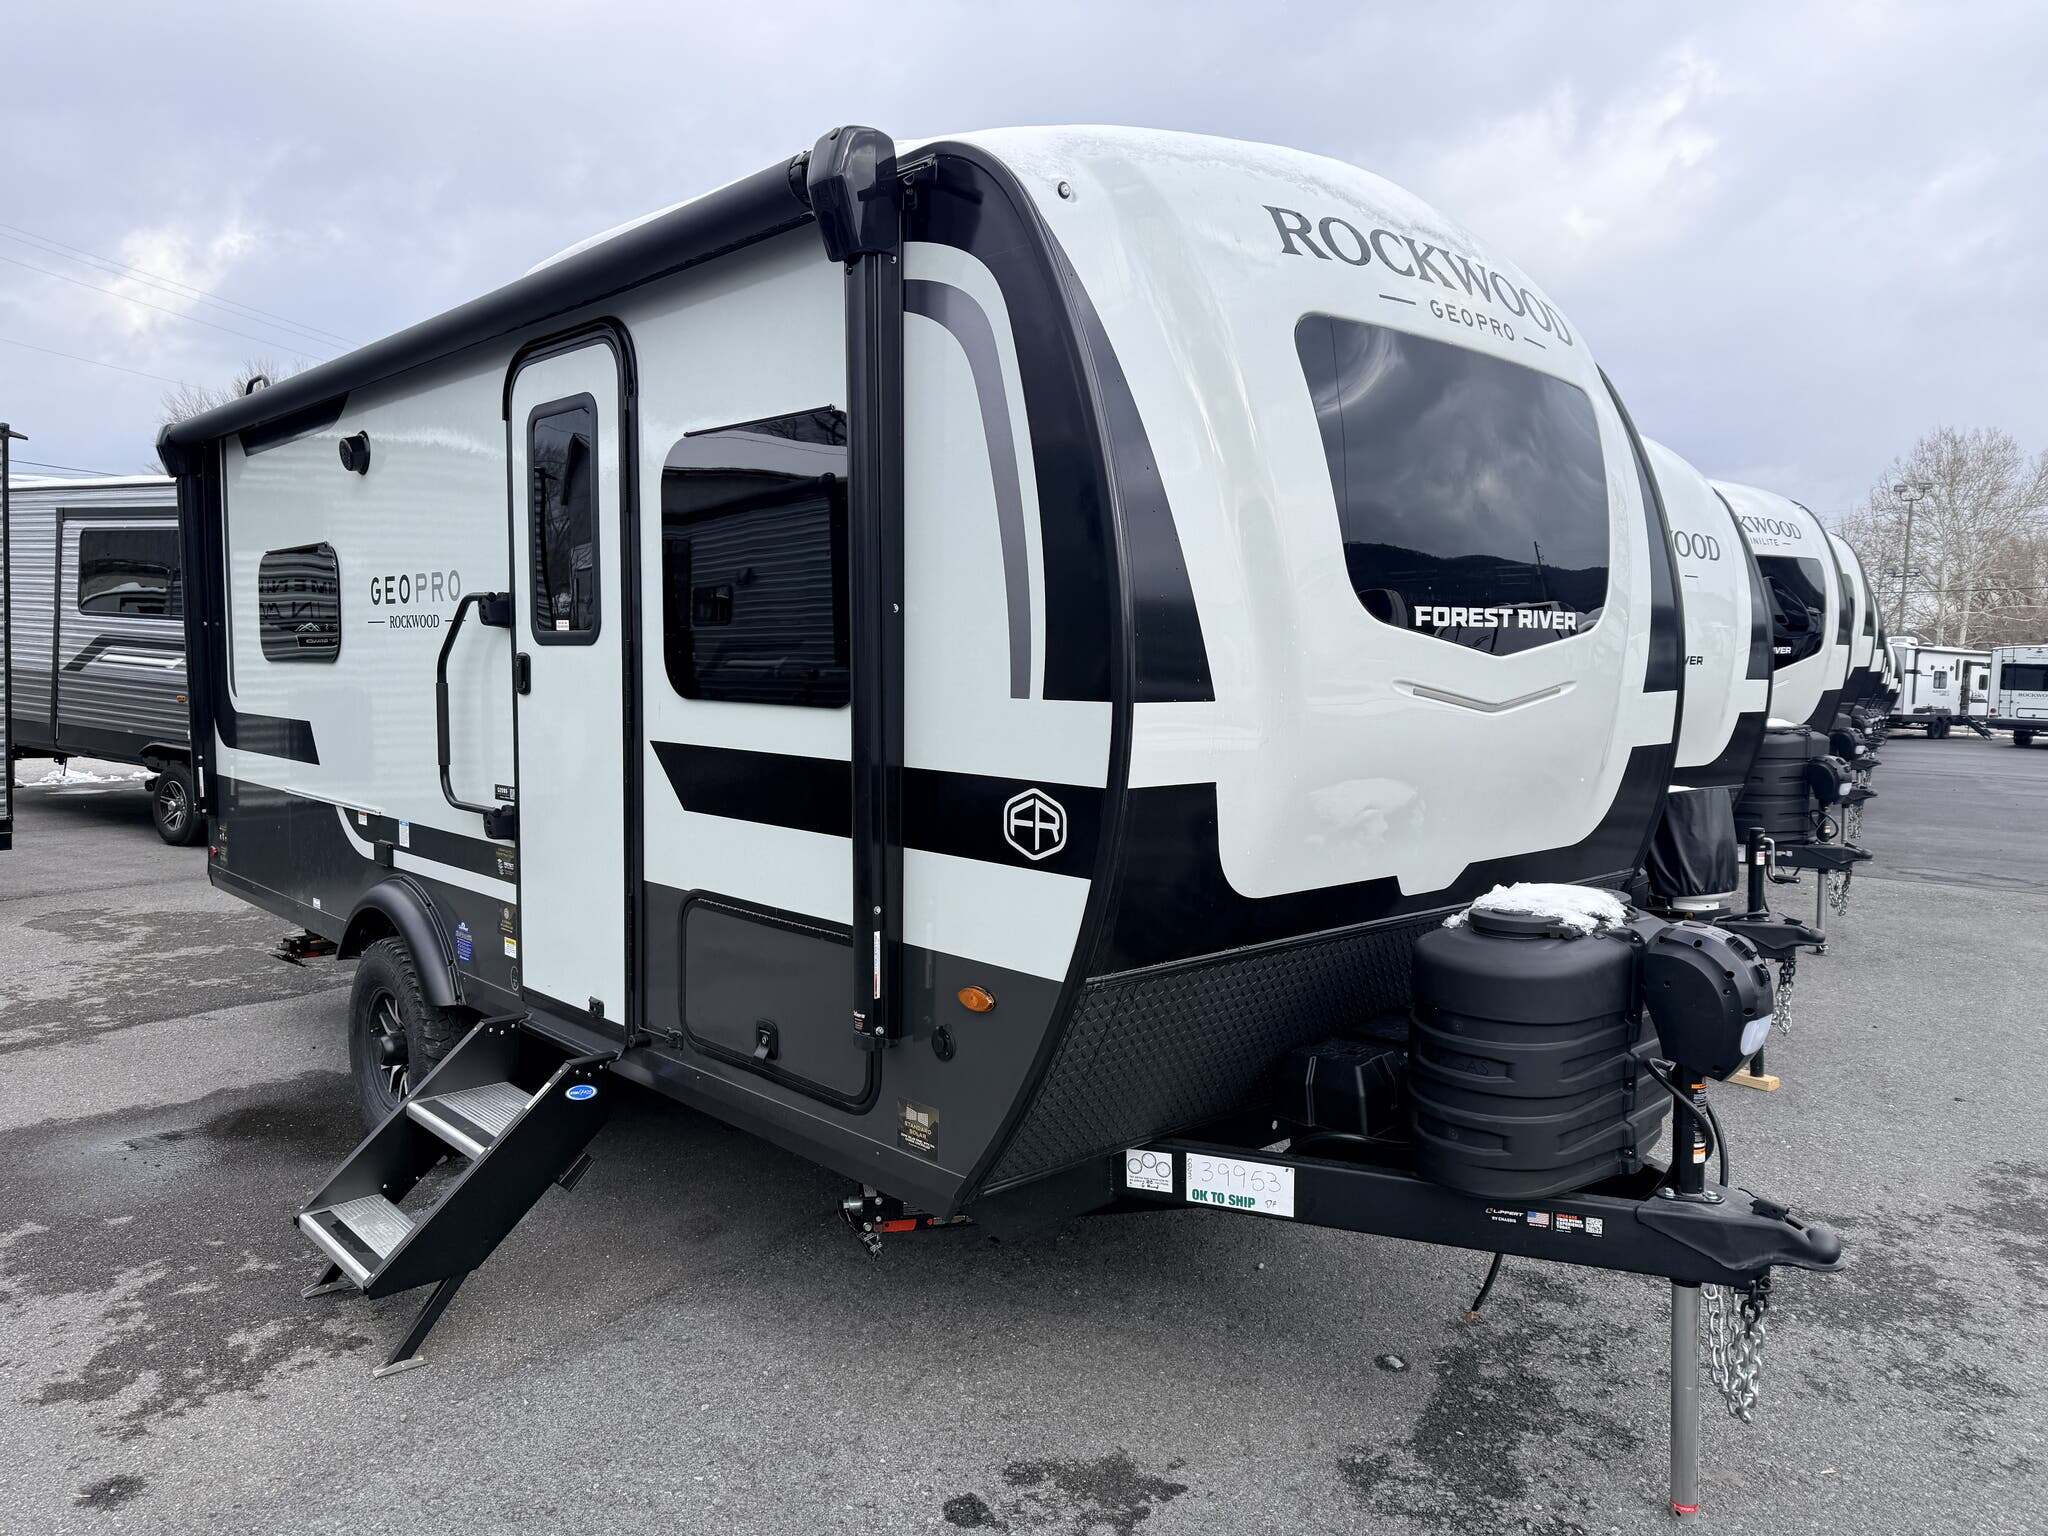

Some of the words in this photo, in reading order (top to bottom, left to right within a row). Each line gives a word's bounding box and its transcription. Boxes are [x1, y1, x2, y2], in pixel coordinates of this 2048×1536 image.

[1261, 204, 1574, 347] ROCKWOOD
[1429, 299, 1516, 342] GEOPRO
[1671, 530, 1721, 561] OOD
[1749, 537, 1780, 547] INILITE
[370, 569, 462, 606] GEOPRO
[389, 613, 441, 630] ROCKWOOD
[1413, 605, 1514, 629] FOREST
[1517, 608, 1578, 630] RIVER
[1191, 1188, 1208, 1202] OK
[1210, 1191, 1225, 1205] TO
[1228, 1194, 1256, 1209] SHIP
